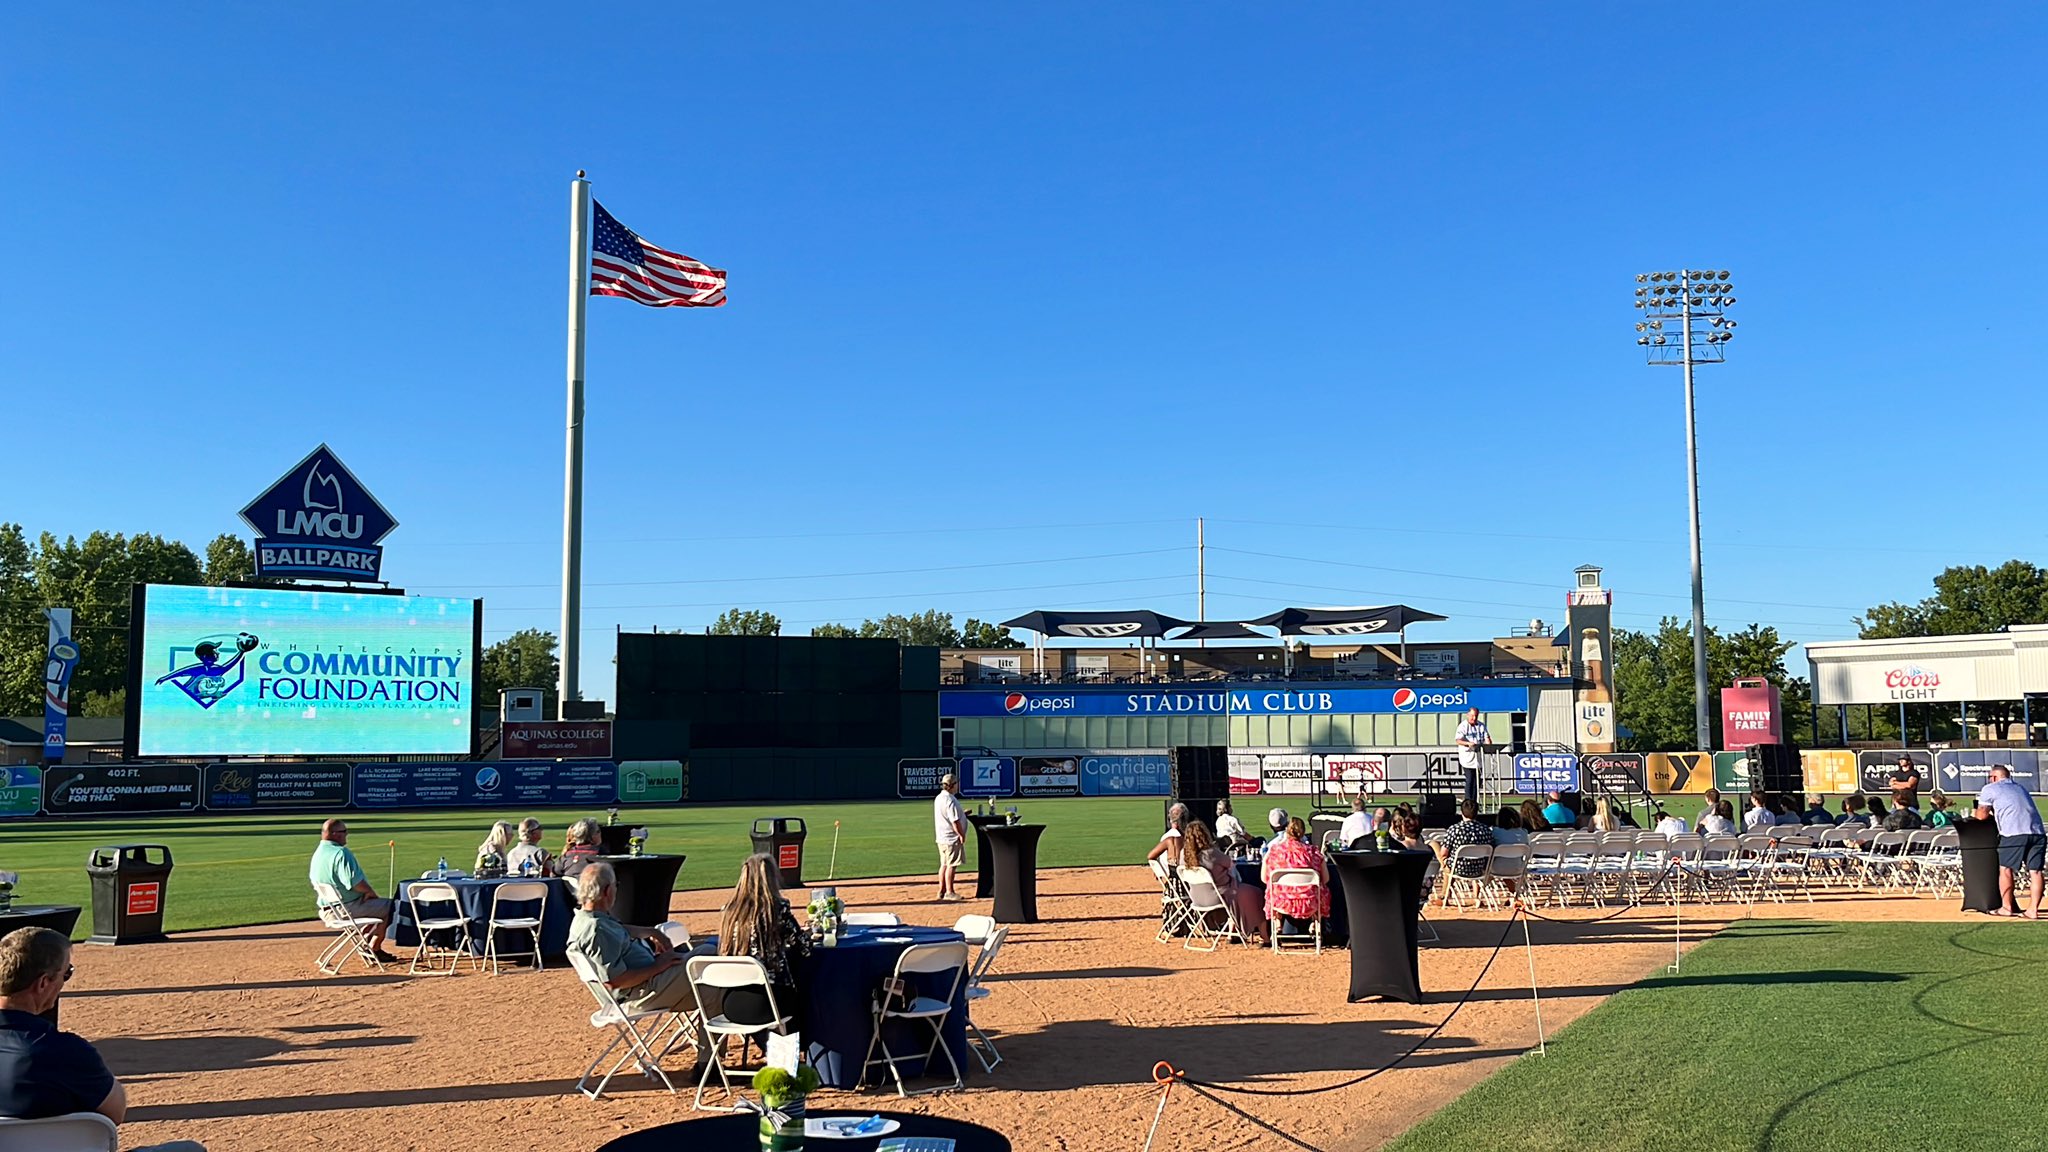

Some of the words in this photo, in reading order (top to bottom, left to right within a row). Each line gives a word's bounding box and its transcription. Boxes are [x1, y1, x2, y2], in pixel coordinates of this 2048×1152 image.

[277, 509, 364, 540] LMCU
[261, 548, 376, 572] BALLPARK
[261, 642, 463, 656] WHITECAPS
[258, 651, 462, 678] COMMUNITY
[1885, 669, 1941, 688] Coors
[258, 677, 461, 702] FOUNDATION
[1891, 688, 1937, 700] LIGHT
[257, 701, 316, 709] ENRICHING
[1030, 695, 1075, 712] pepsi
[1127, 694, 1252, 712] STADIUM
[1262, 692, 1333, 711] CLUB
[1419, 691, 1468, 709] pepsi
[1582, 705, 1605, 720] Lite
[1728, 711, 1771, 721] FAMILY
[1735, 720, 1768, 730] FARE.
[509, 729, 558, 741] AQUINAS
[559, 729, 605, 739] COLLEGE
[536, 742, 578, 750] aquinas.edu
[1085, 757, 1172, 776] Confiden
[1519, 757, 1573, 769] GREAT
[107, 769, 126, 777] 402
[127, 769, 141, 777] FT.
[903, 767, 937, 777] TRAVERSE
[937, 766, 953, 776] CITY
[1328, 761, 1384, 780] BURGESS
[1654, 771, 1670, 780] the
[213, 769, 252, 793] Lee
[647, 777, 679, 785] WMGB
[906, 776, 937, 785] WHISKEY
[69, 786, 105, 795] YOU'RE
[106, 786, 143, 794] GONNA
[143, 785, 168, 793] NEED
[168, 784, 192, 793] MILK
[68, 794, 87, 803] FOR
[89, 794, 116, 802] THAT.
